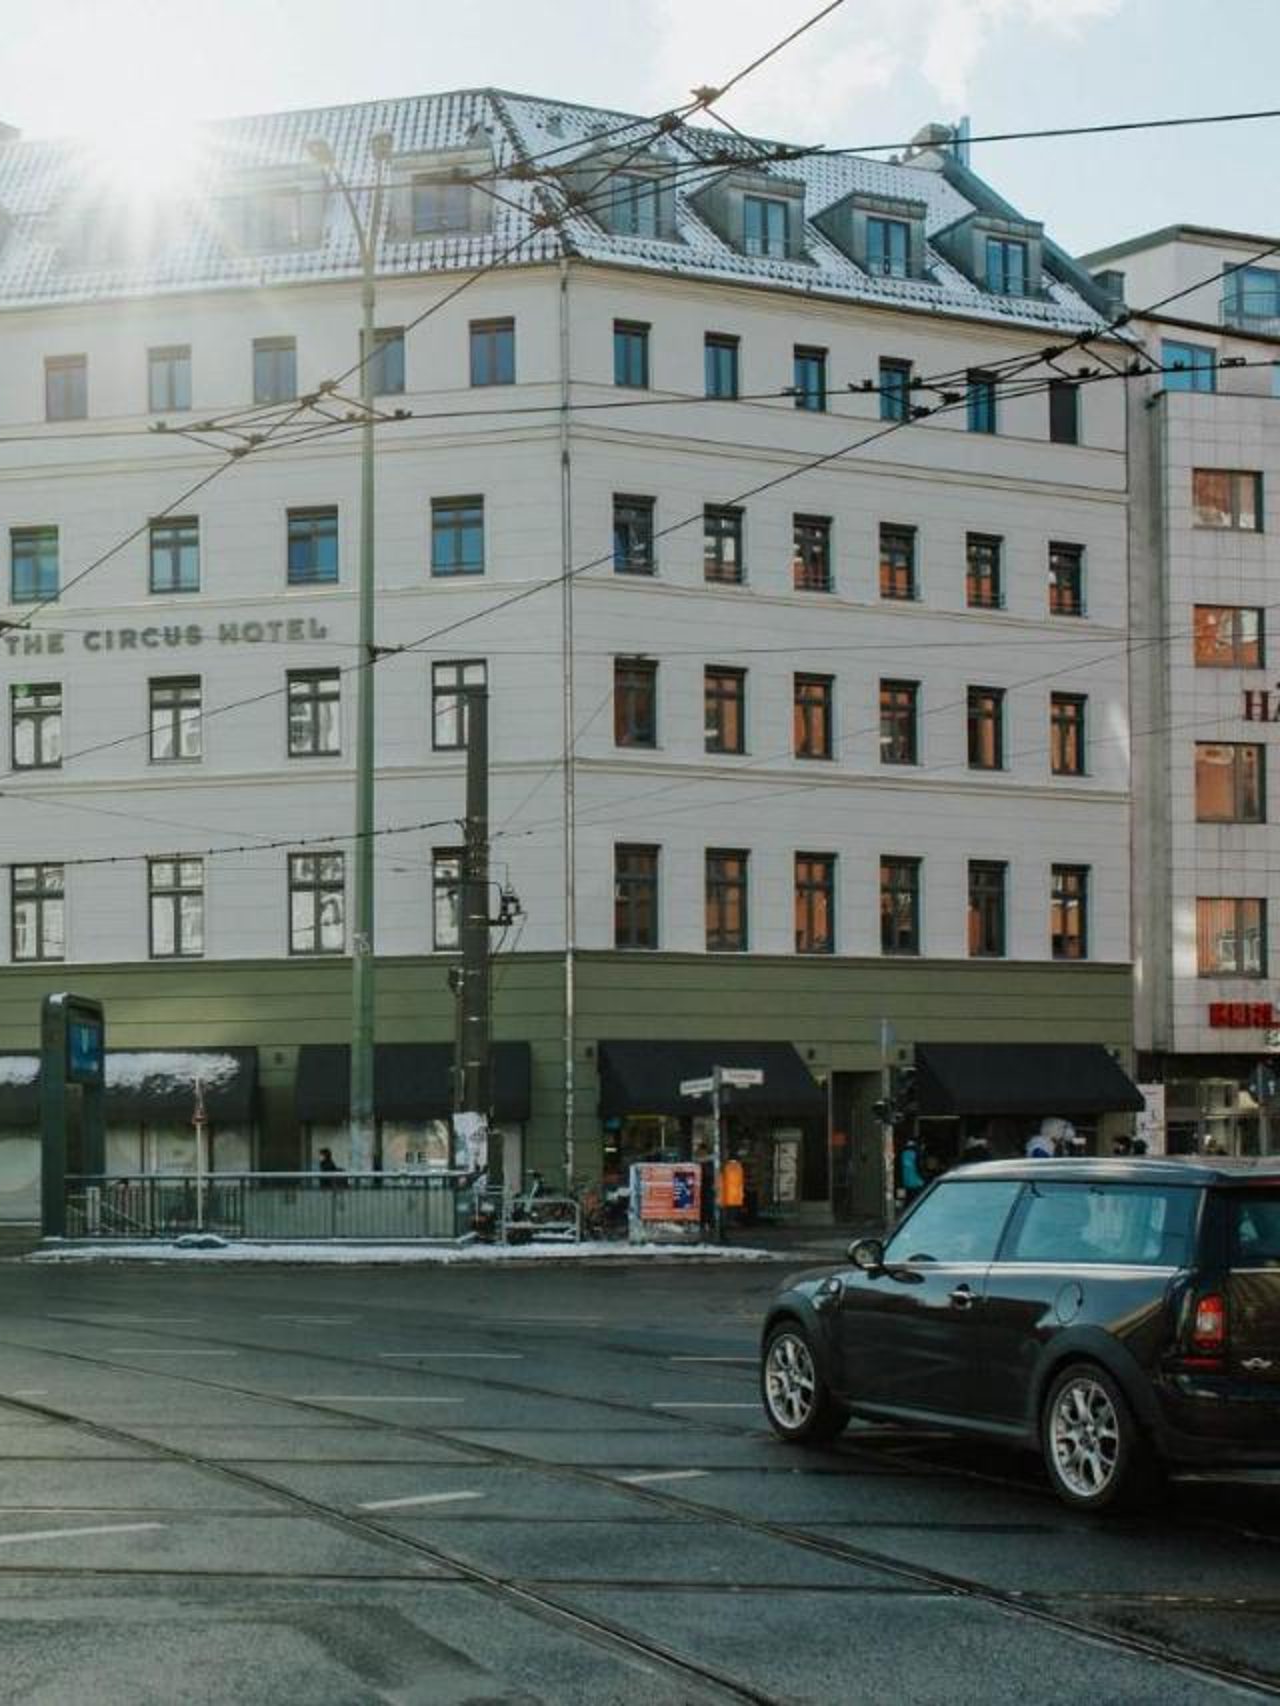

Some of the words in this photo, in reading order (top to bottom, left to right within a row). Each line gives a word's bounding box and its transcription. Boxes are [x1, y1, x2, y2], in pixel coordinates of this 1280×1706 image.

[4, 633, 65, 656] THE
[83, 625, 202, 652] CIRCUS
[219, 617, 328, 645] HOTEL
